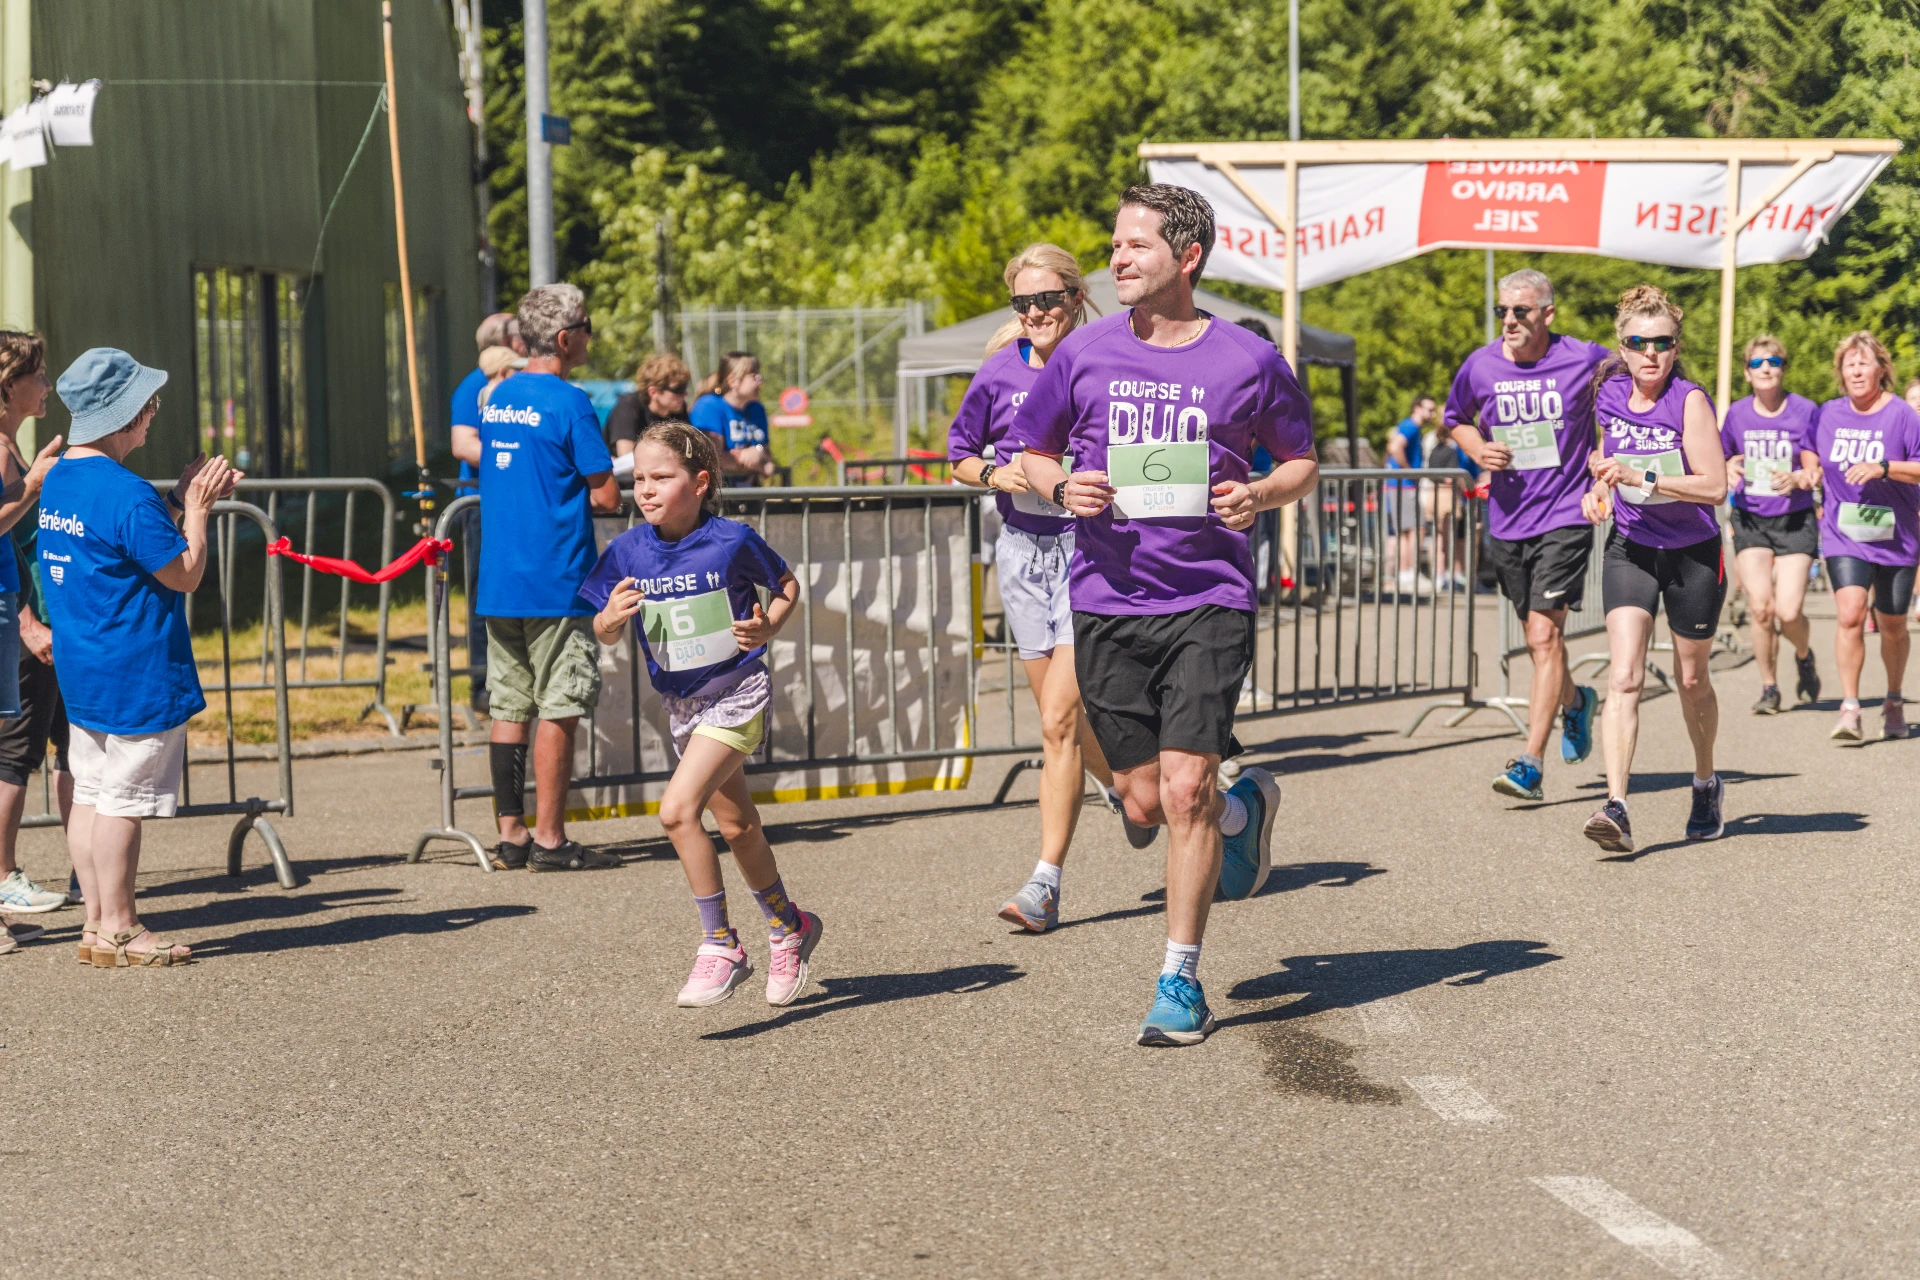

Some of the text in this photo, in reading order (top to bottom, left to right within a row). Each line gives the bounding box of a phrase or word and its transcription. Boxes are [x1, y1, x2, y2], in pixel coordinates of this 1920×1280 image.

[1109, 380, 1182, 400] COURSE
[1493, 380, 1542, 393] COURSE
[1496, 391, 1563, 422] DUO
[1109, 401, 1208, 444] DUO
[1505, 427, 1539, 449] 56
[1635, 440, 1674, 450] SUISSE
[1829, 439, 1884, 464] DUO
[1143, 449, 1172, 482] 6
[1143, 492, 1175, 506] DUO
[39, 508, 84, 537] énévole
[669, 604, 696, 636] 6
[675, 643, 706, 660] DUO
